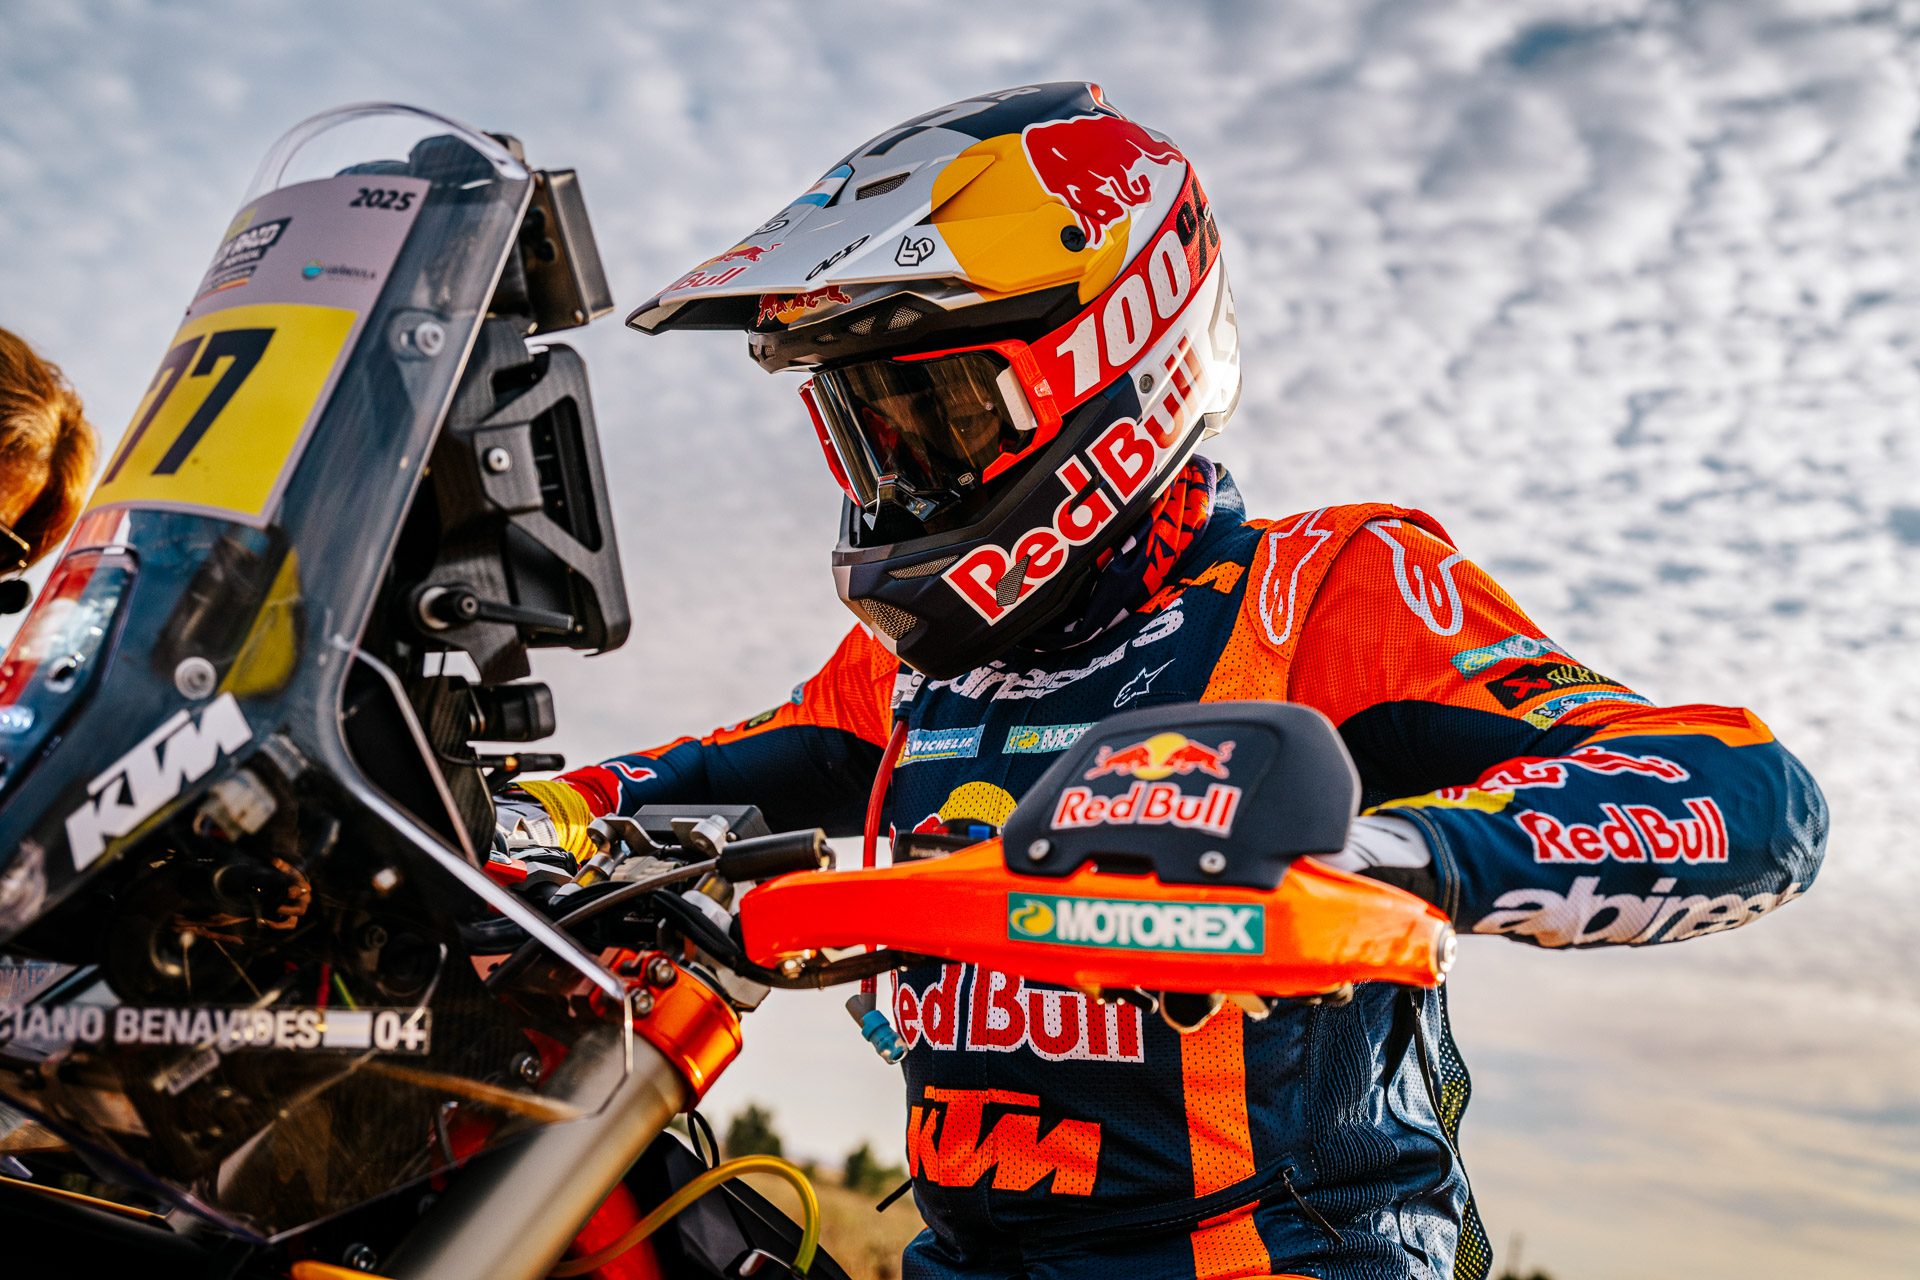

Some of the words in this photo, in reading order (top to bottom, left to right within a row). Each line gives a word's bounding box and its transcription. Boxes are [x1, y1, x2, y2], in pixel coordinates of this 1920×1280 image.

[349, 187, 416, 211] 2025
[670, 265, 751, 292] Bull
[894, 235, 935, 267] 6D
[102, 327, 277, 487] 77
[941, 454, 1118, 626] Red
[1085, 328, 1212, 506] Bull
[65, 690, 254, 872] KTM
[1050, 780, 1147, 830] Red
[1136, 781, 1242, 839] Bull
[1513, 803, 1648, 864] Red
[1622, 796, 1729, 865] Bull
[1056, 899, 1255, 950] MOTOREX
[114, 1007, 321, 1049] BENAVIDES
[890, 963, 966, 1051] ed
[966, 960, 1145, 1063] Bull
[907, 1085, 1101, 1196] KTM
